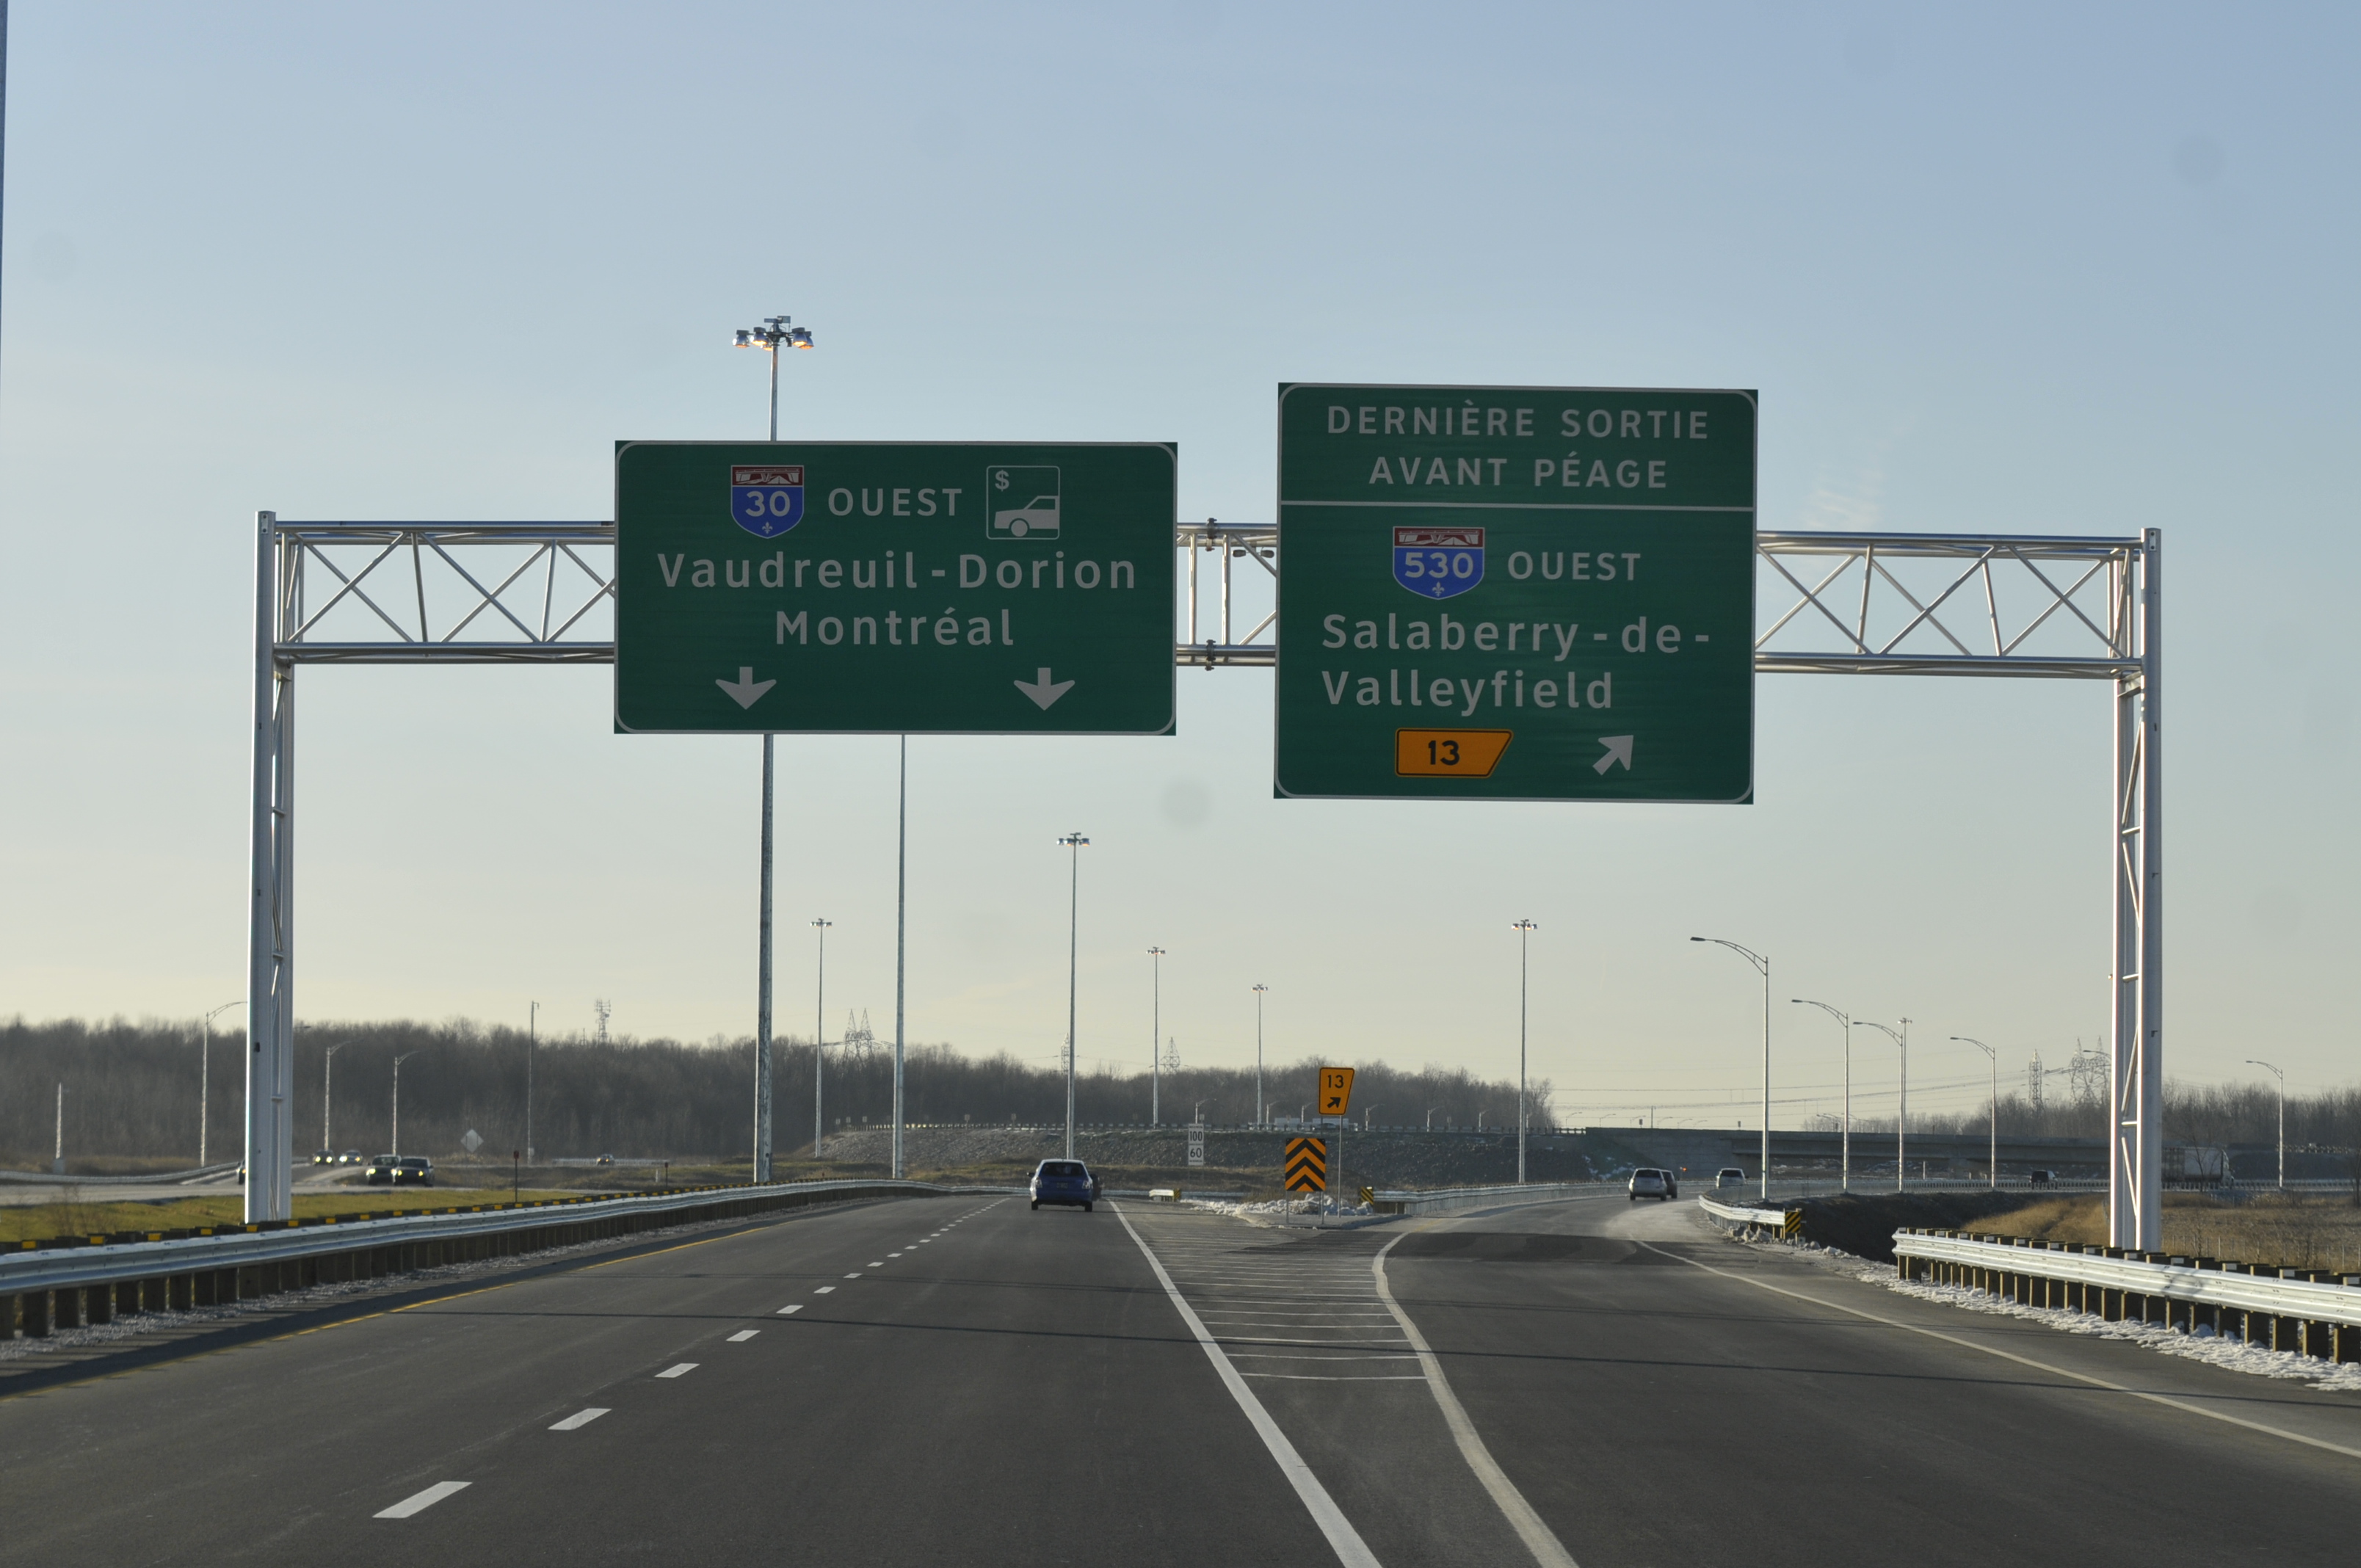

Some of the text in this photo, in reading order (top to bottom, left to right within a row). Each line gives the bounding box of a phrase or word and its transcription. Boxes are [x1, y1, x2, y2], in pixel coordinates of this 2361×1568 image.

[1328, 399, 1708, 439] DERNIÈRE SORTIE
[1368, 451, 1667, 488] AVANT PÉAGE
[745, 490, 791, 517] 30
[828, 487, 962, 517] OUEST
[657, 550, 1134, 589] Vaudreuil-Dorion
[1404, 552, 1474, 578] 530
[1507, 551, 1641, 581] OUEST
[776, 606, 1014, 646] Montréal
[1321, 669, 1611, 717] Valleyfield
[1427, 738, 1460, 766] 13
[1327, 1075, 1344, 1088] 13
[1189, 1130, 1203, 1141] 100
[1190, 1147, 1203, 1158] 60
